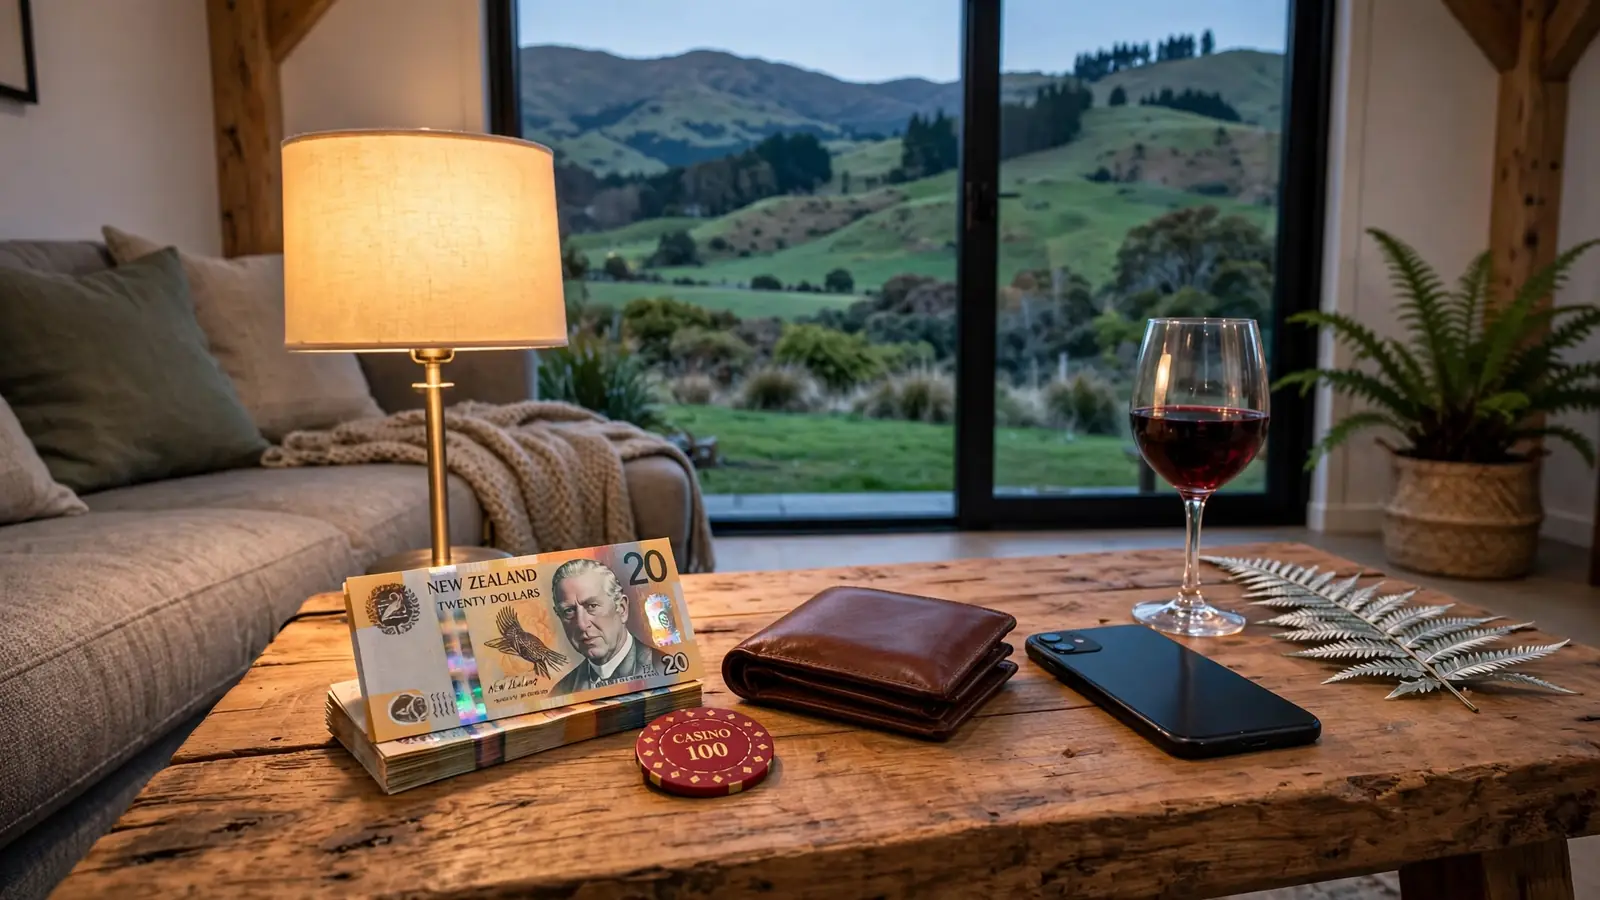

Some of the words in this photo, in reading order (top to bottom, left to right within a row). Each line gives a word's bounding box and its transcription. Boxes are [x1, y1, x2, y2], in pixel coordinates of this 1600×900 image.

[623, 549, 668, 586] 20
[427, 577, 464, 595] NEW
[468, 568, 538, 590] ZEALAND
[437, 595, 491, 611] TWENTY
[491, 588, 541, 604] DOLLARS
[661, 651, 690, 676] 20
[672, 728, 731, 744] CASINO
[685, 742, 729, 761] 100
